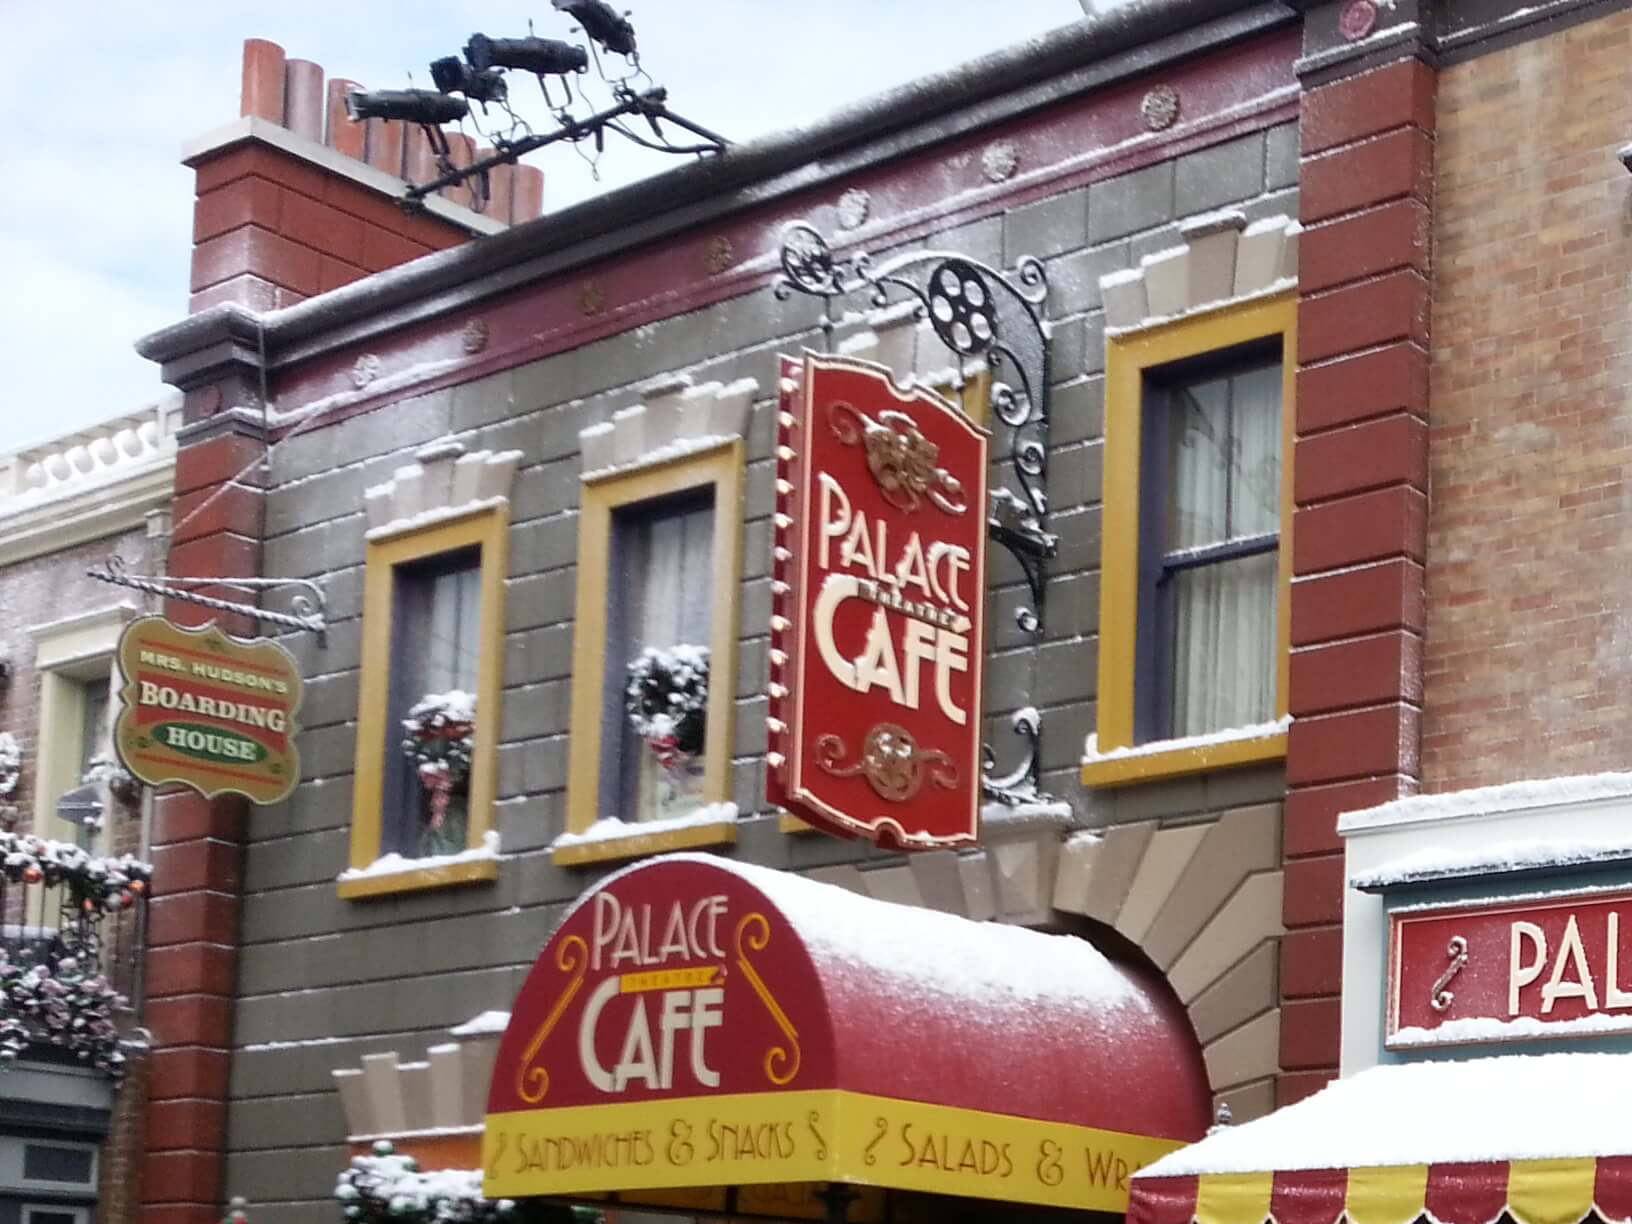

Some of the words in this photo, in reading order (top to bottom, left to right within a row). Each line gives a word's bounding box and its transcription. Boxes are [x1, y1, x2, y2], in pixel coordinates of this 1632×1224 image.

[818, 471, 970, 611] PALACE
[139, 650, 187, 671] MRS.
[191, 662, 289, 694] HUDSON'S
[813, 573, 968, 726] CAFE
[139, 681, 287, 733] BOARDING
[166, 726, 258, 761] HOUSE
[591, 891, 729, 971] PALACE
[579, 975, 725, 1093] CAFE
[514, 1127, 654, 1175] SANDWICHES
[667, 1118, 695, 1167] &
[706, 1117, 796, 1163] SNACKS
[900, 1122, 1014, 1178] SALADS
[1036, 1139, 1065, 1187] &
[1085, 1147, 1142, 1193] WR
